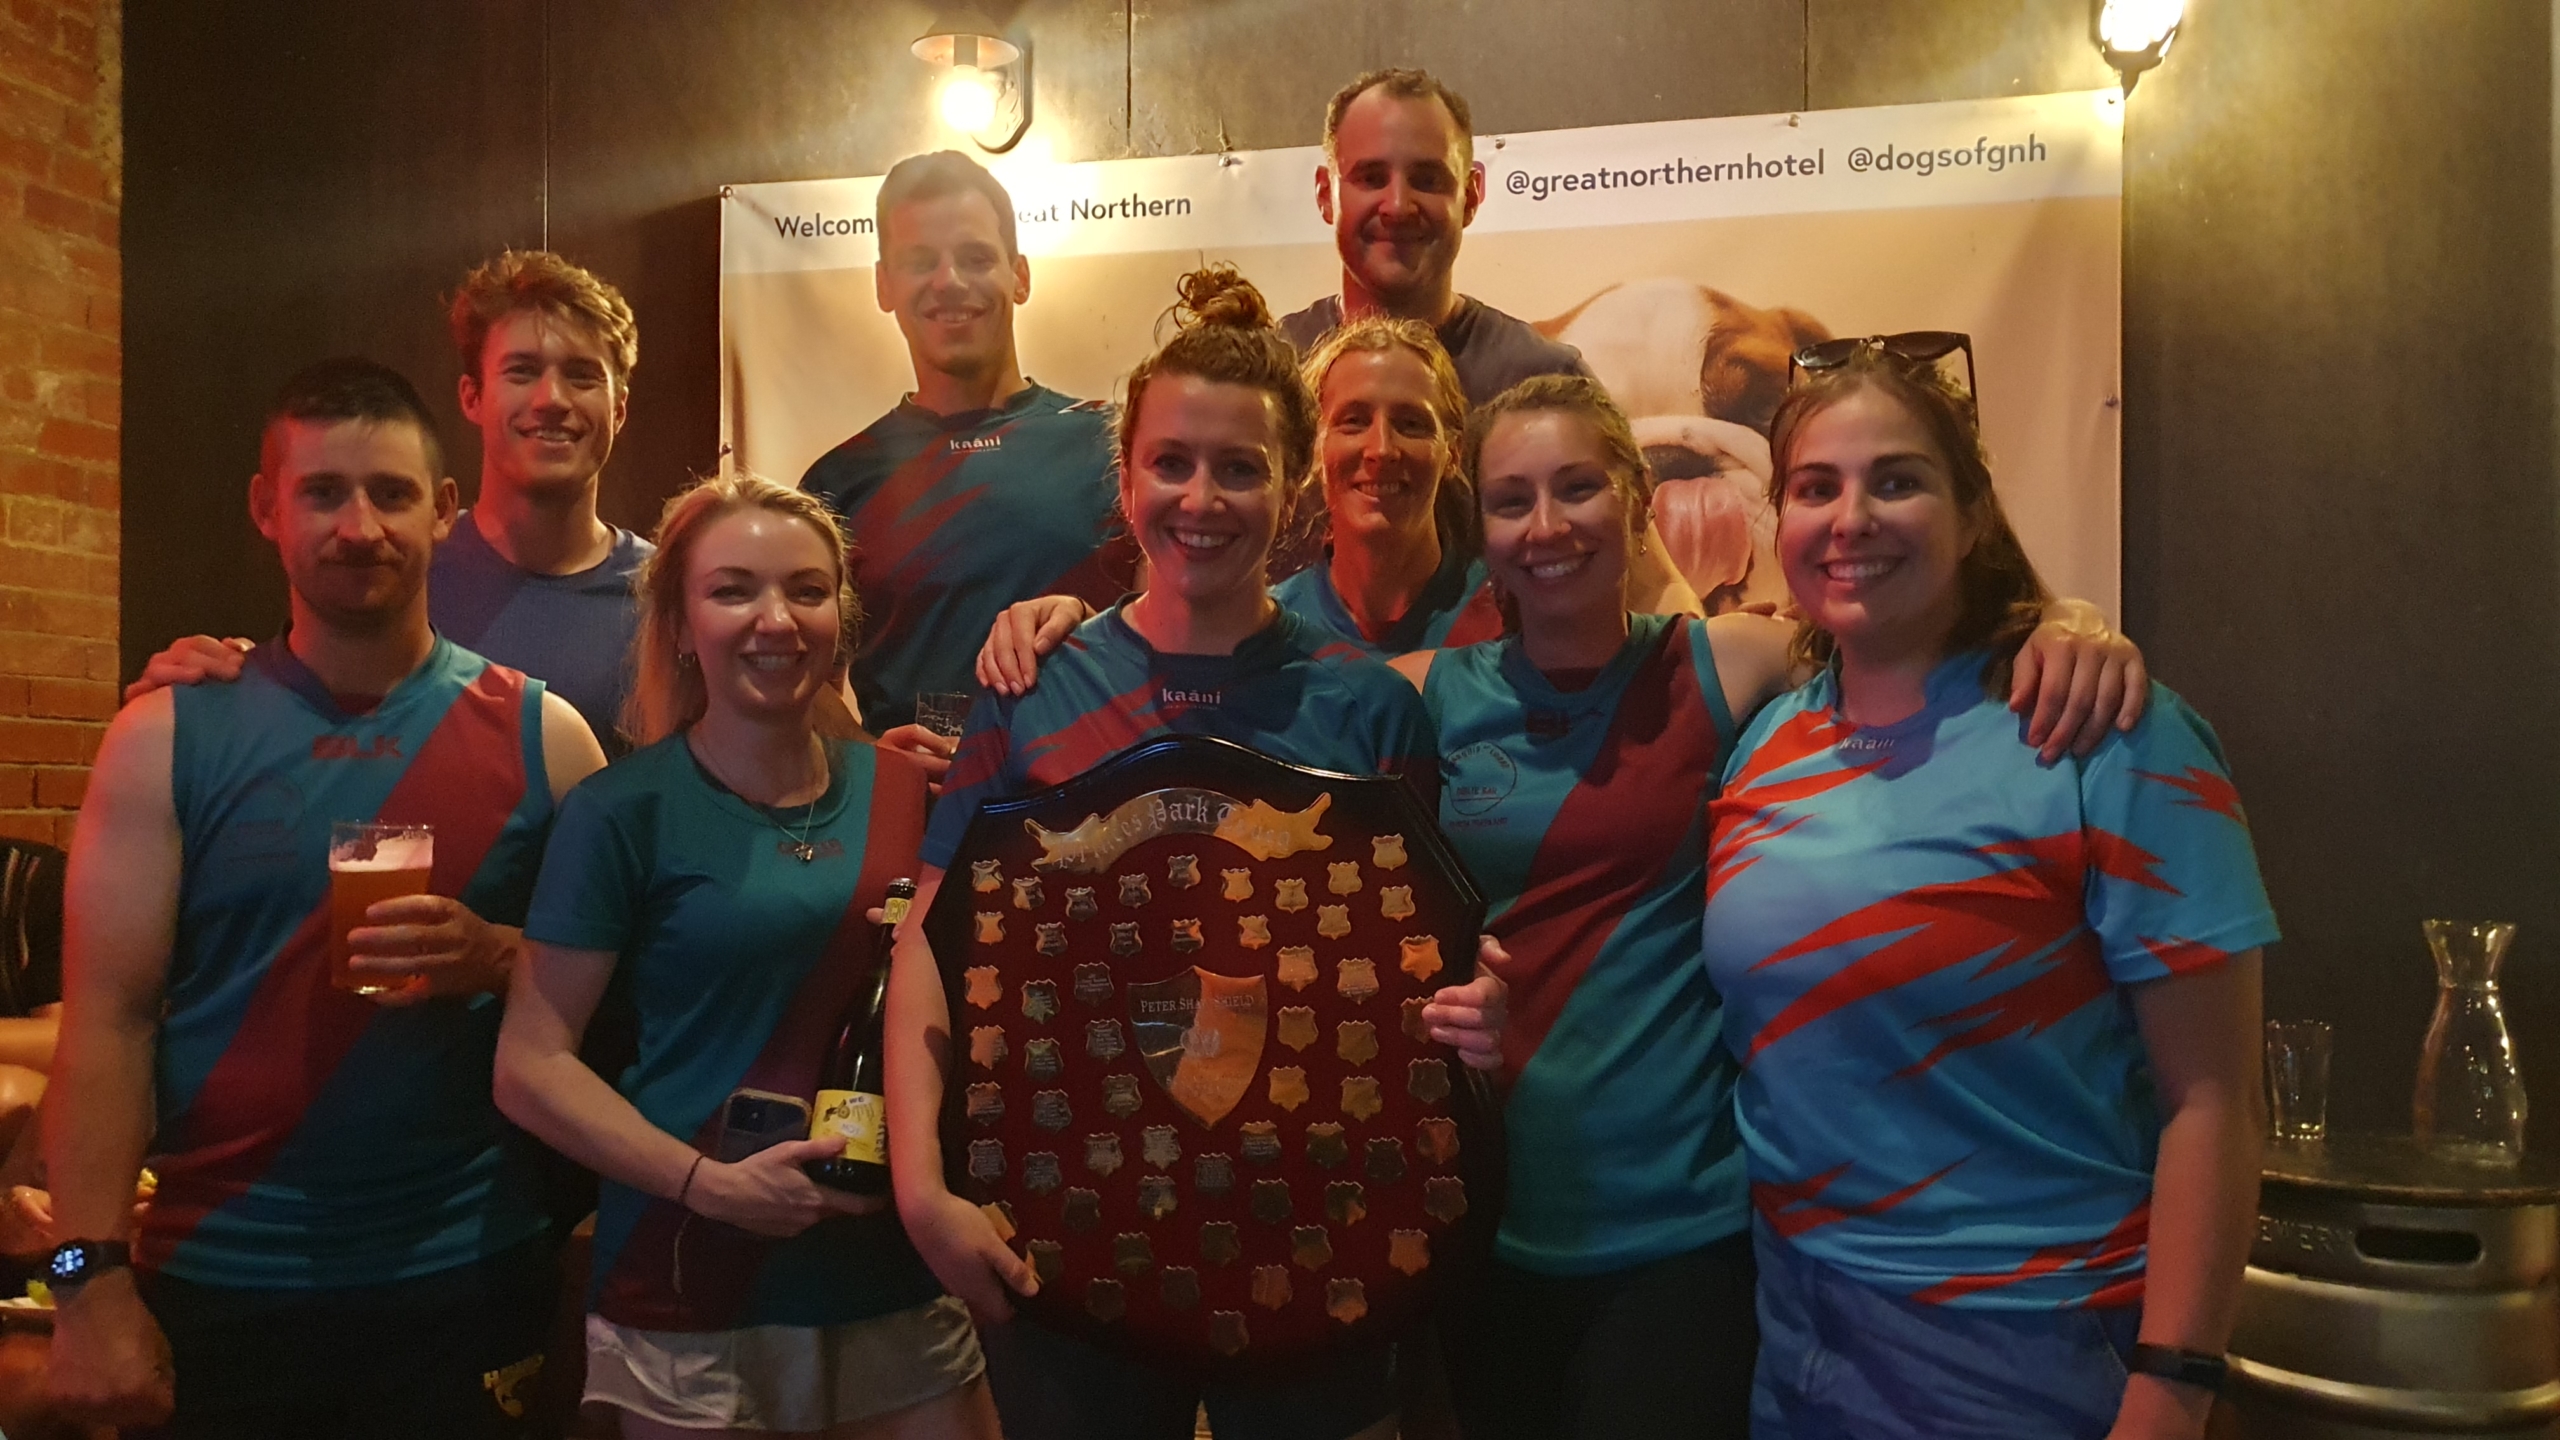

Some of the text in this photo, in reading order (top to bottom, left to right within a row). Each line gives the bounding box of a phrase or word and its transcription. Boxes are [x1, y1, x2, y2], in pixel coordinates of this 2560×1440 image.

[1505, 134, 2047, 201] @greatnorthernhotel @dogsofgnh
[774, 193, 1191, 239] Welcom eat Northern
[1147, 796, 1209, 832] Park
[1141, 1000, 1176, 1013] PETER
